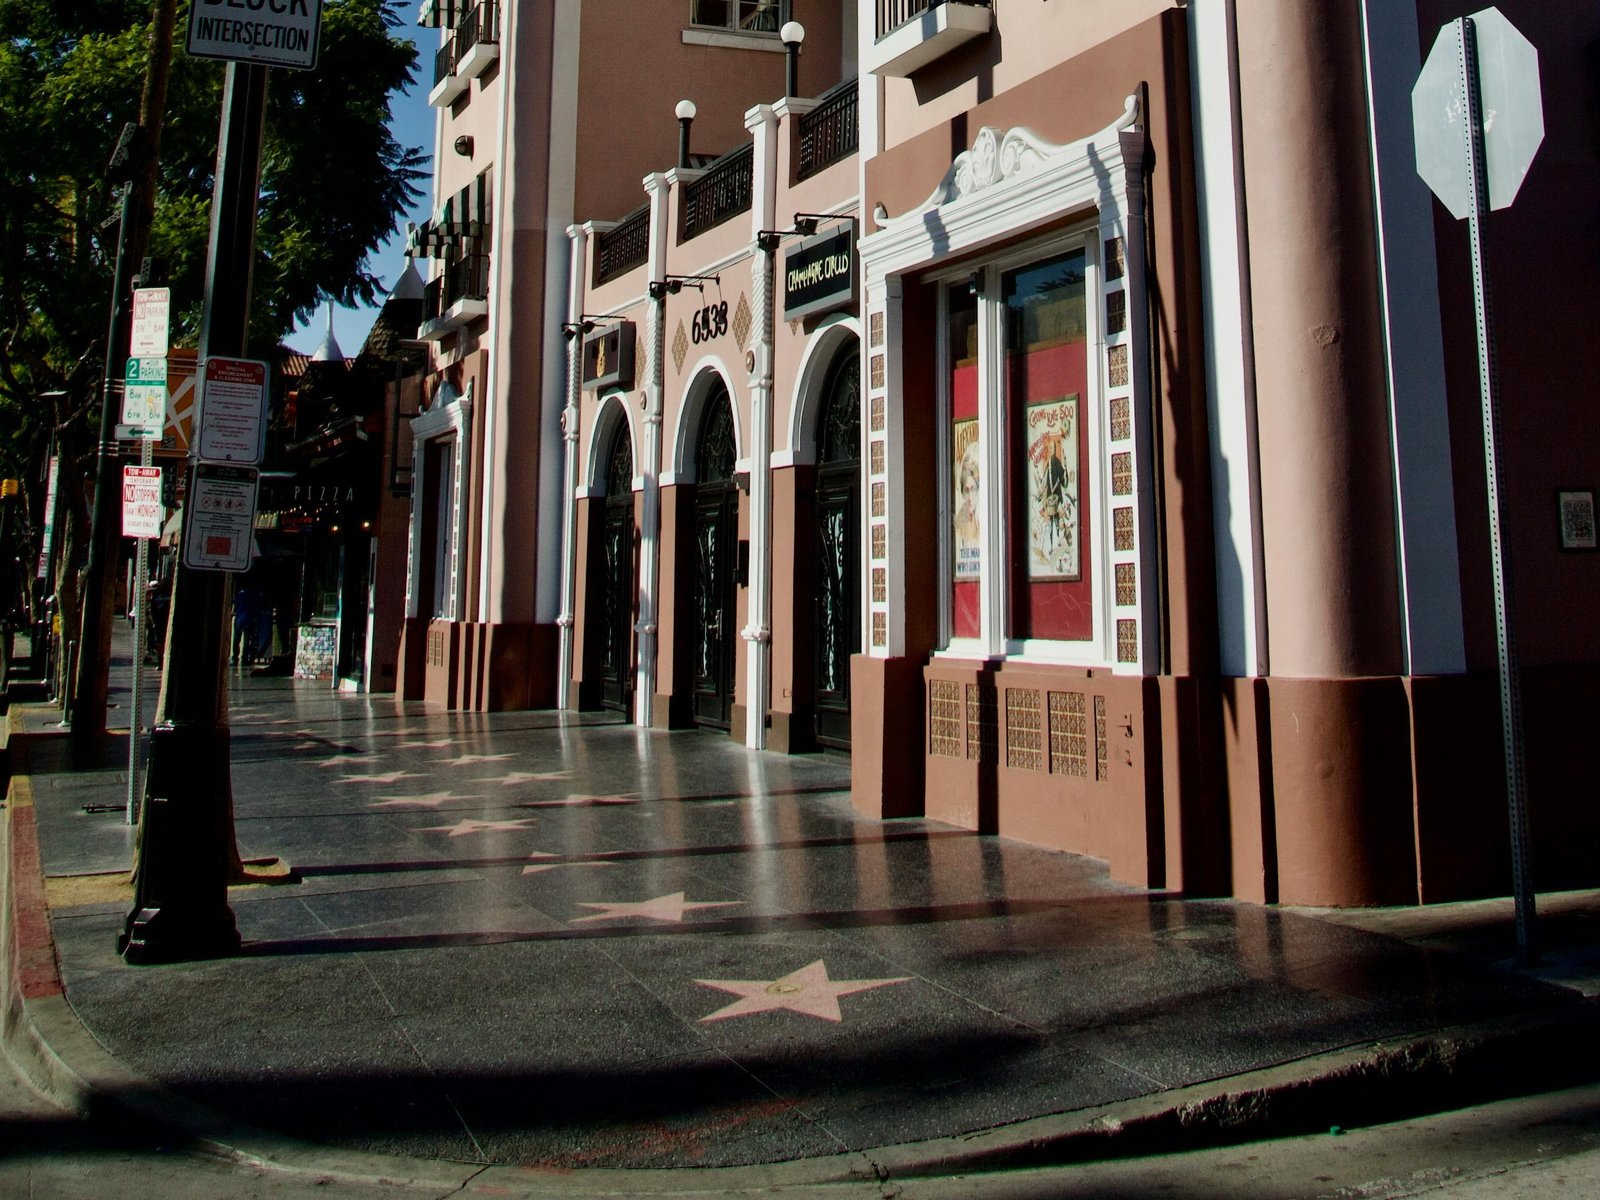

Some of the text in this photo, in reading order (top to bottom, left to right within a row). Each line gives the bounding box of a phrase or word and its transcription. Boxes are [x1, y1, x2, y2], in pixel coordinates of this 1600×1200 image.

[196, 16, 309, 52] INTERSECTION
[129, 361, 137, 377] 2
[128, 468, 157, 477] TOW-AWAY
[125, 485, 135, 501] NO
[294, 485, 354, 501] PIZZA
